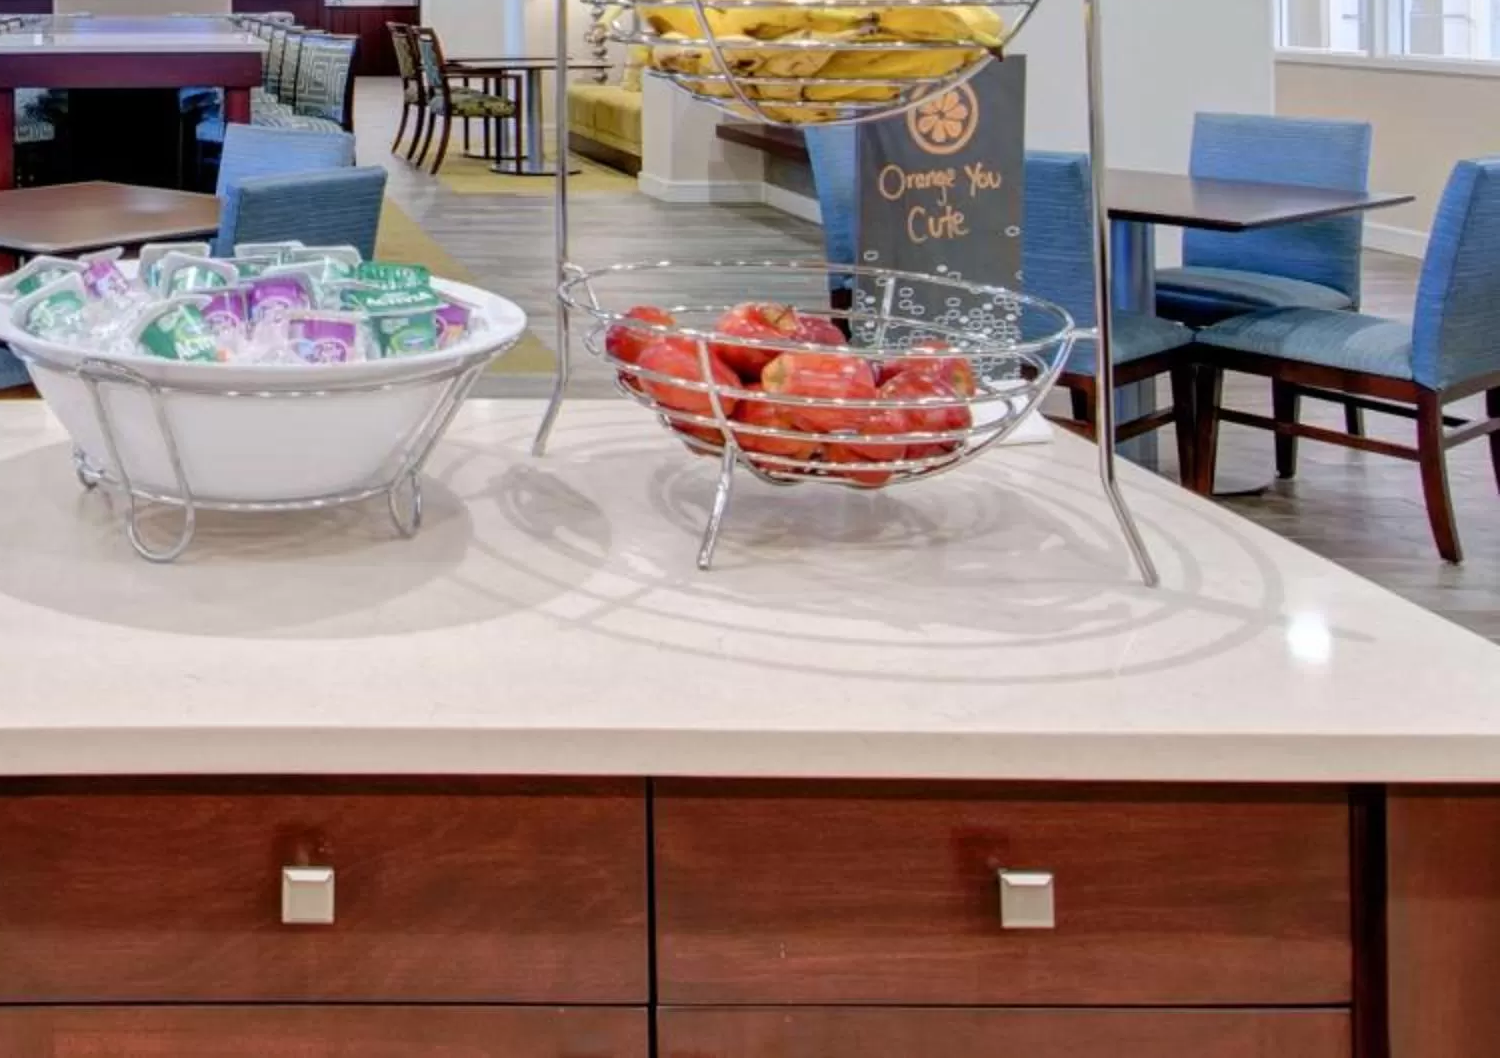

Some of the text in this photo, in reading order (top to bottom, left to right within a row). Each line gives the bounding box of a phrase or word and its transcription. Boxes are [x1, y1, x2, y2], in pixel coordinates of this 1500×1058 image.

[879, 162, 1002, 206] Orange You
[907, 206, 970, 243] Cute
